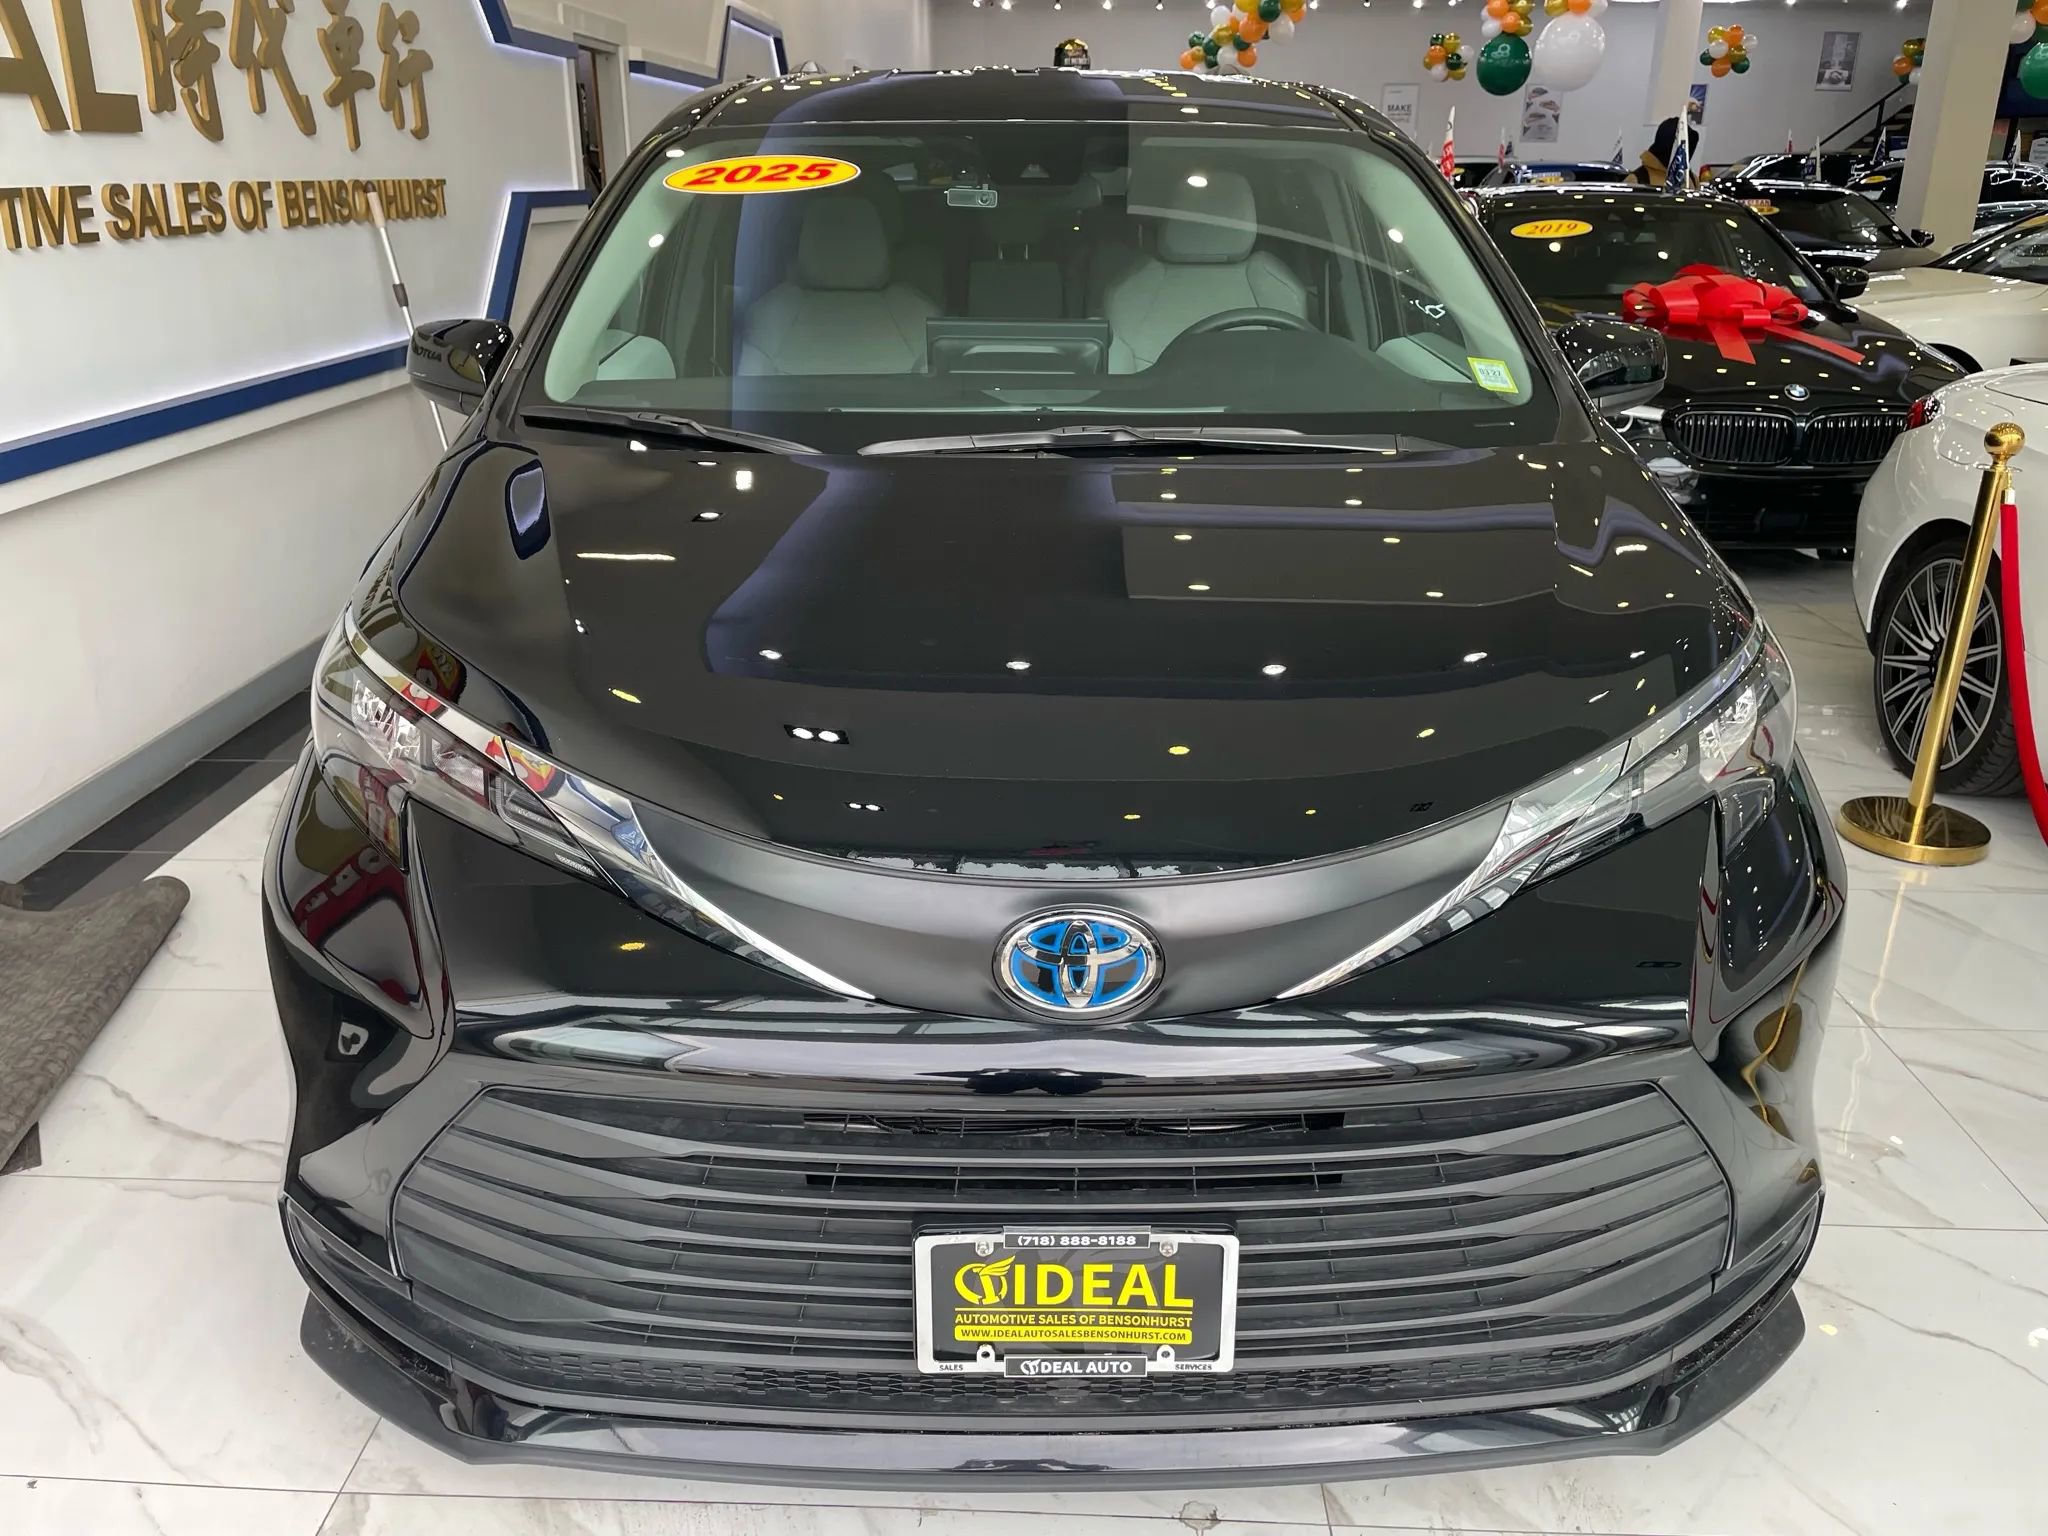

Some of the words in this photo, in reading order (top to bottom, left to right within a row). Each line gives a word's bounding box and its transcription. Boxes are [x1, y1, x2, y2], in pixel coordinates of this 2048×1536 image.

[683, 163, 838, 187] 2025
[100, 181, 227, 241] SALES
[229, 180, 273, 232] OF
[1526, 222, 1578, 236] 2019
[1018, 1235, 1055, 1247] (718)
[1060, 1235, 1137, 1247] 888-8188
[1014, 1263, 1194, 1308] IDEAL
[954, 1313, 1036, 1325] AUTOMOTIVE
[1038, 1314, 1076, 1325] SALES
[1079, 1314, 1096, 1325] OF
[1098, 1315, 1193, 1328] BENSONHURST
[960, 1328, 1186, 1341] WWW.IDEALAUTOSALESBENSONHURST.COM
[1085, 1361, 1132, 1374] AUTO
[1175, 1363, 1212, 1371] SERVICES
